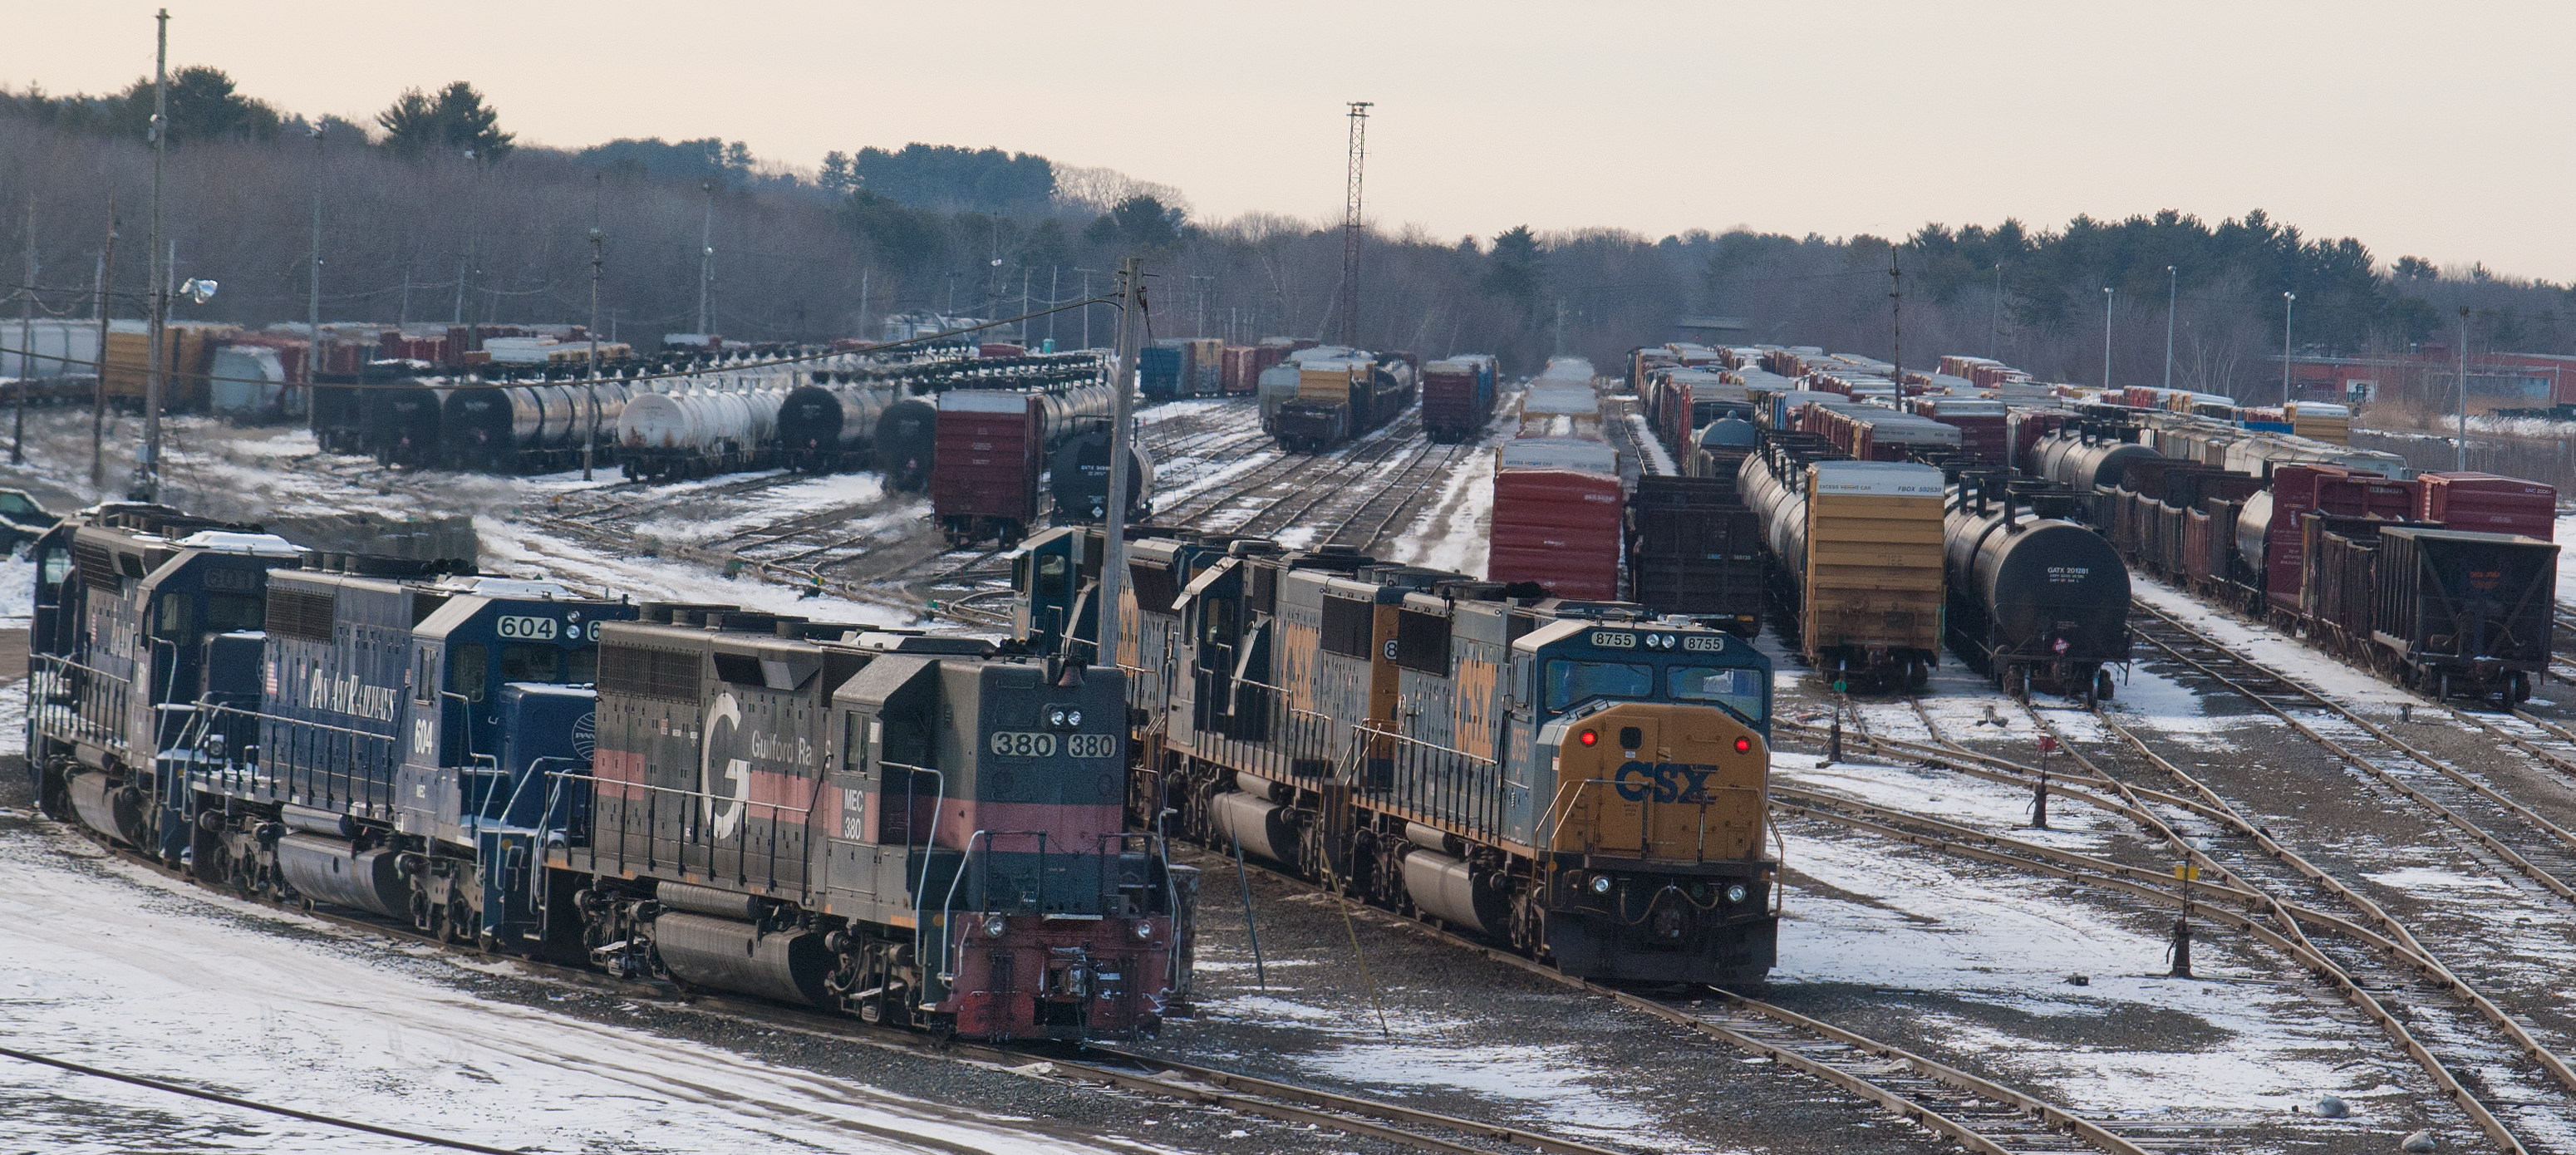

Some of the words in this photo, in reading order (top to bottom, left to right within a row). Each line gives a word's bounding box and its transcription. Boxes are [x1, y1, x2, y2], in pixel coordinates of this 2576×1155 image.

[501, 617, 553, 638] 604
[1596, 633, 1632, 646] 8755
[1689, 637, 1720, 650] 8755
[310, 669, 331, 710] PAN
[331, 671, 349, 713] AM
[347, 675, 396, 722] RAILWAYS
[1455, 657, 1496, 765] CSX
[415, 719, 433, 754] 604
[751, 730, 794, 764] Guilford
[997, 734, 1050, 756] 380
[1072, 735, 1113, 756] 380
[1512, 726, 1529, 763] 8755
[702, 692, 751, 839] G
[1615, 760, 1720, 804] CSX
[844, 789, 863, 812] MEC
[844, 818, 861, 839] 380
